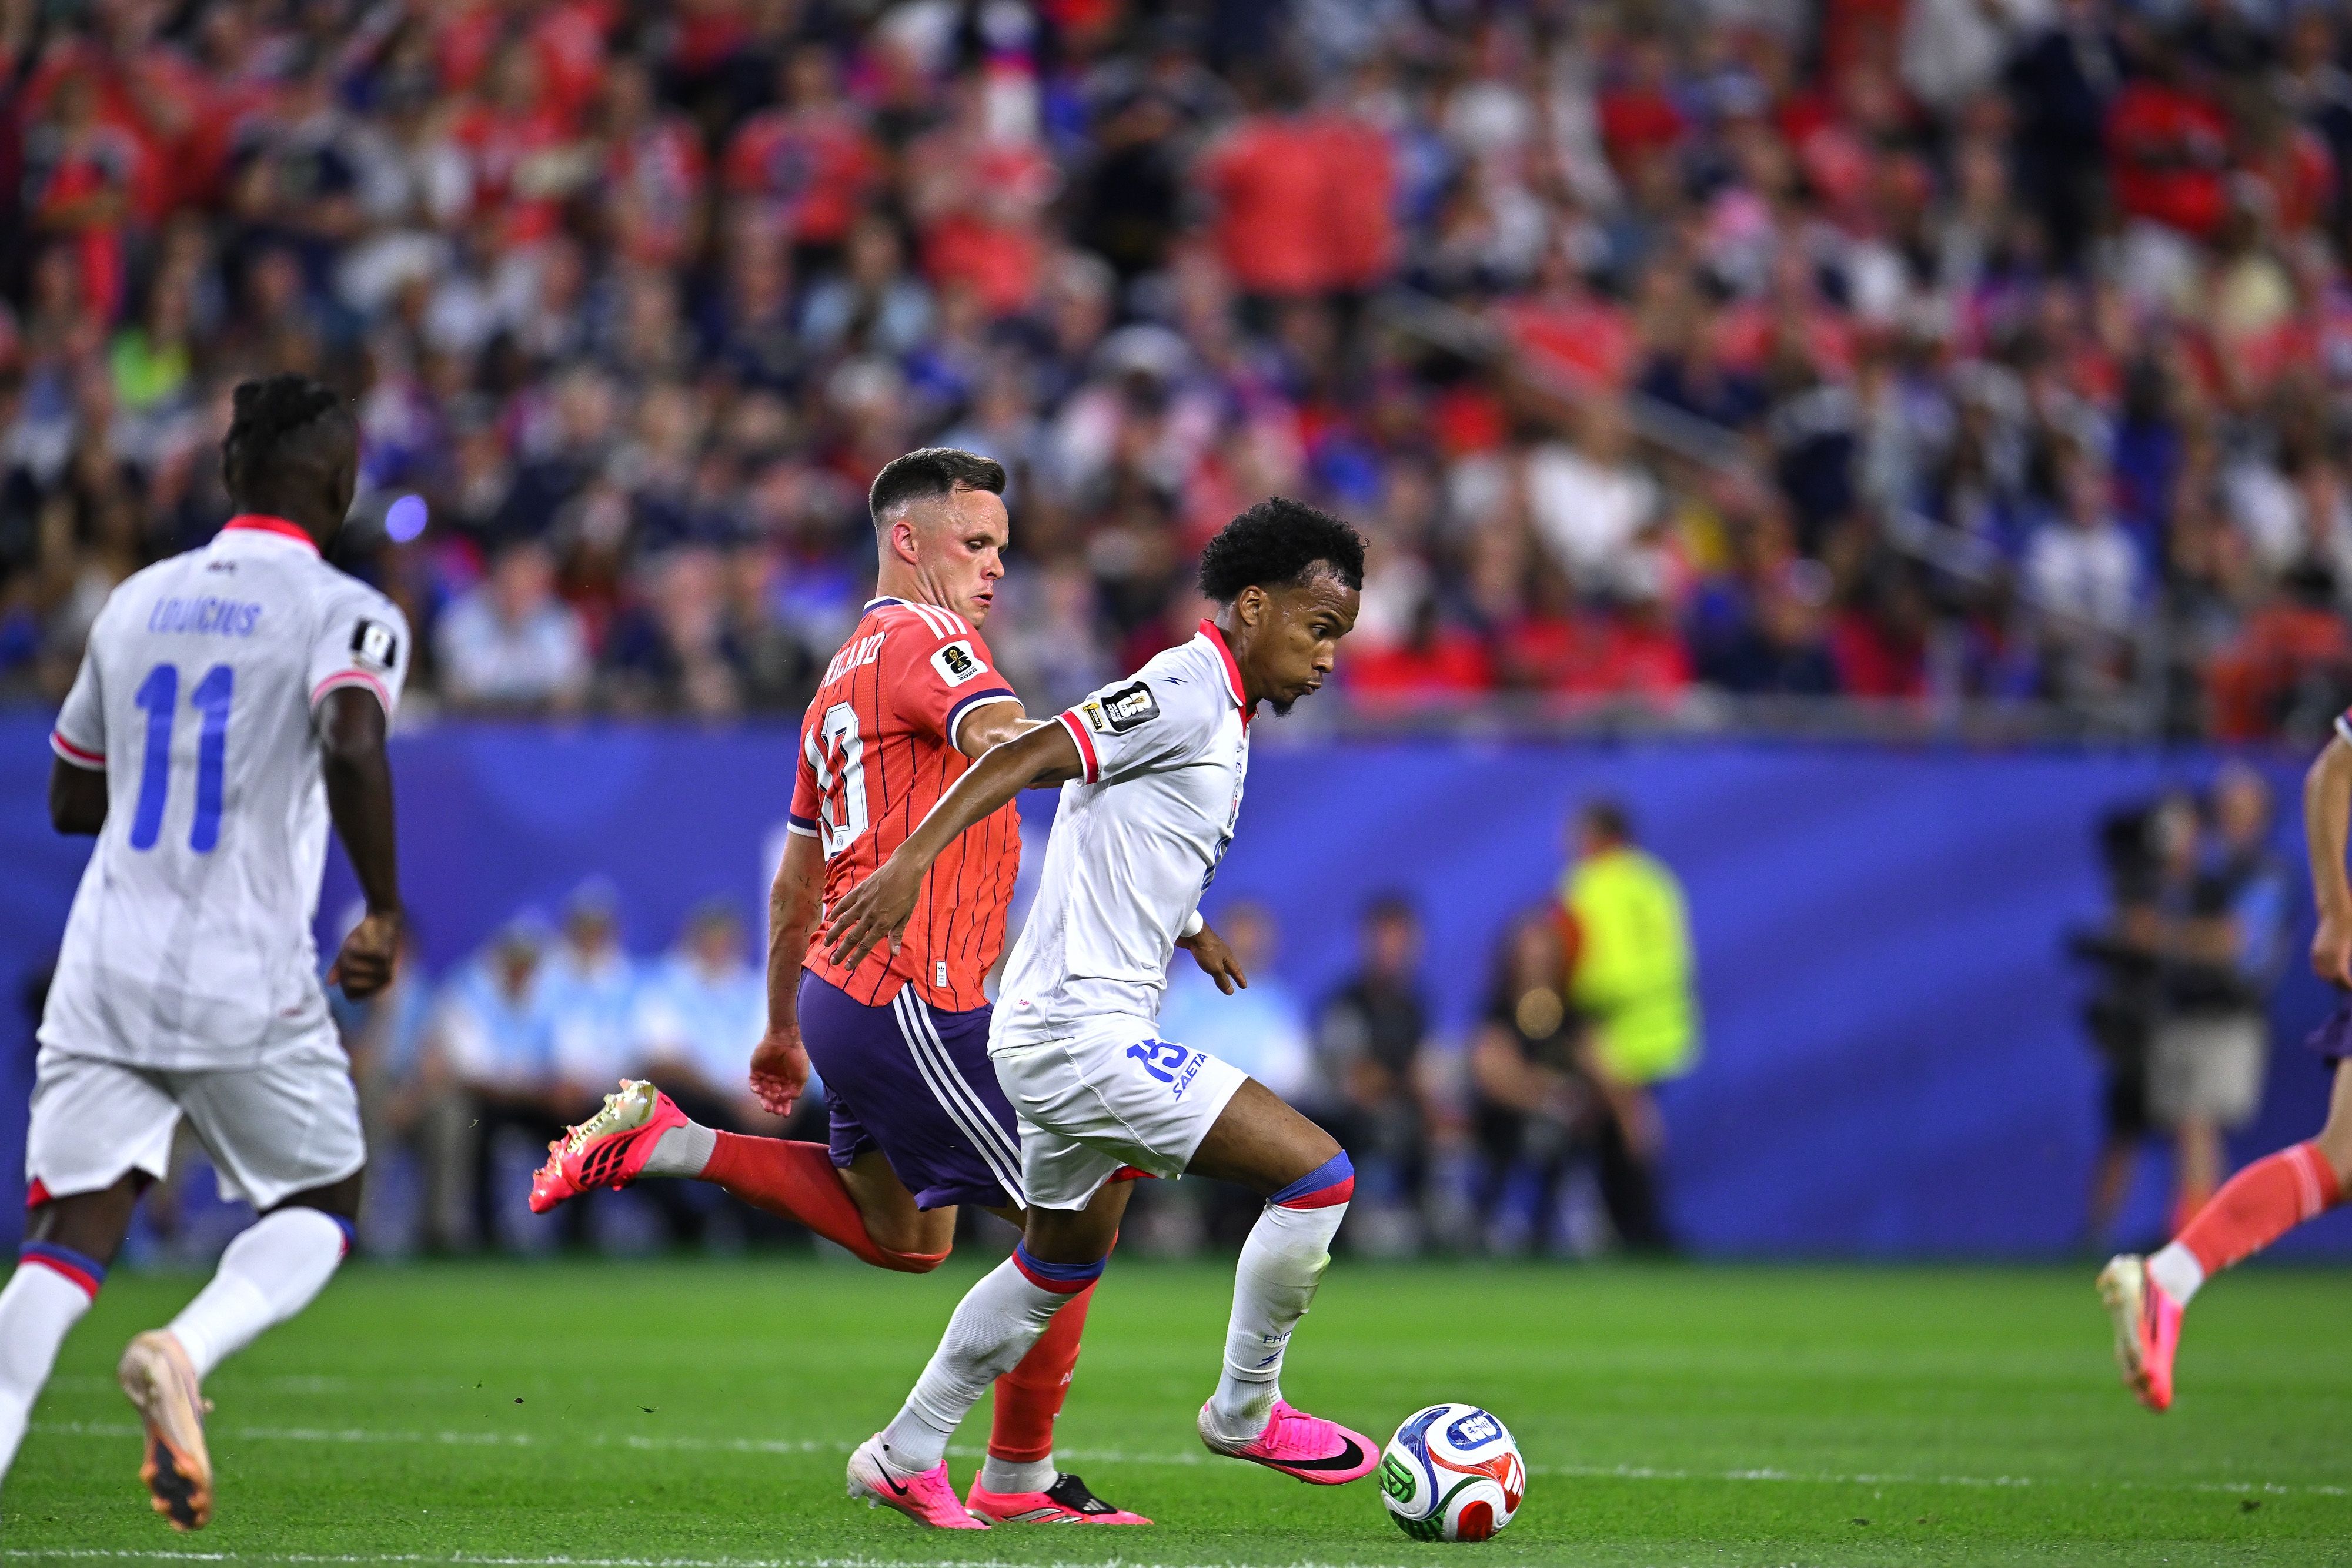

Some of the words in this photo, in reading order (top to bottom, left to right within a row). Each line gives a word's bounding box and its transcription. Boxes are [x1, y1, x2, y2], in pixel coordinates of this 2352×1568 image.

[958, 668, 978, 681] 2026
[1091, 709, 1102, 727] DEBUT
[129, 663, 233, 853] 11
[1127, 1038, 1188, 1083] 15
[1172, 1052, 1208, 1102] SAETA
[1262, 1330, 1292, 1344] FHF
